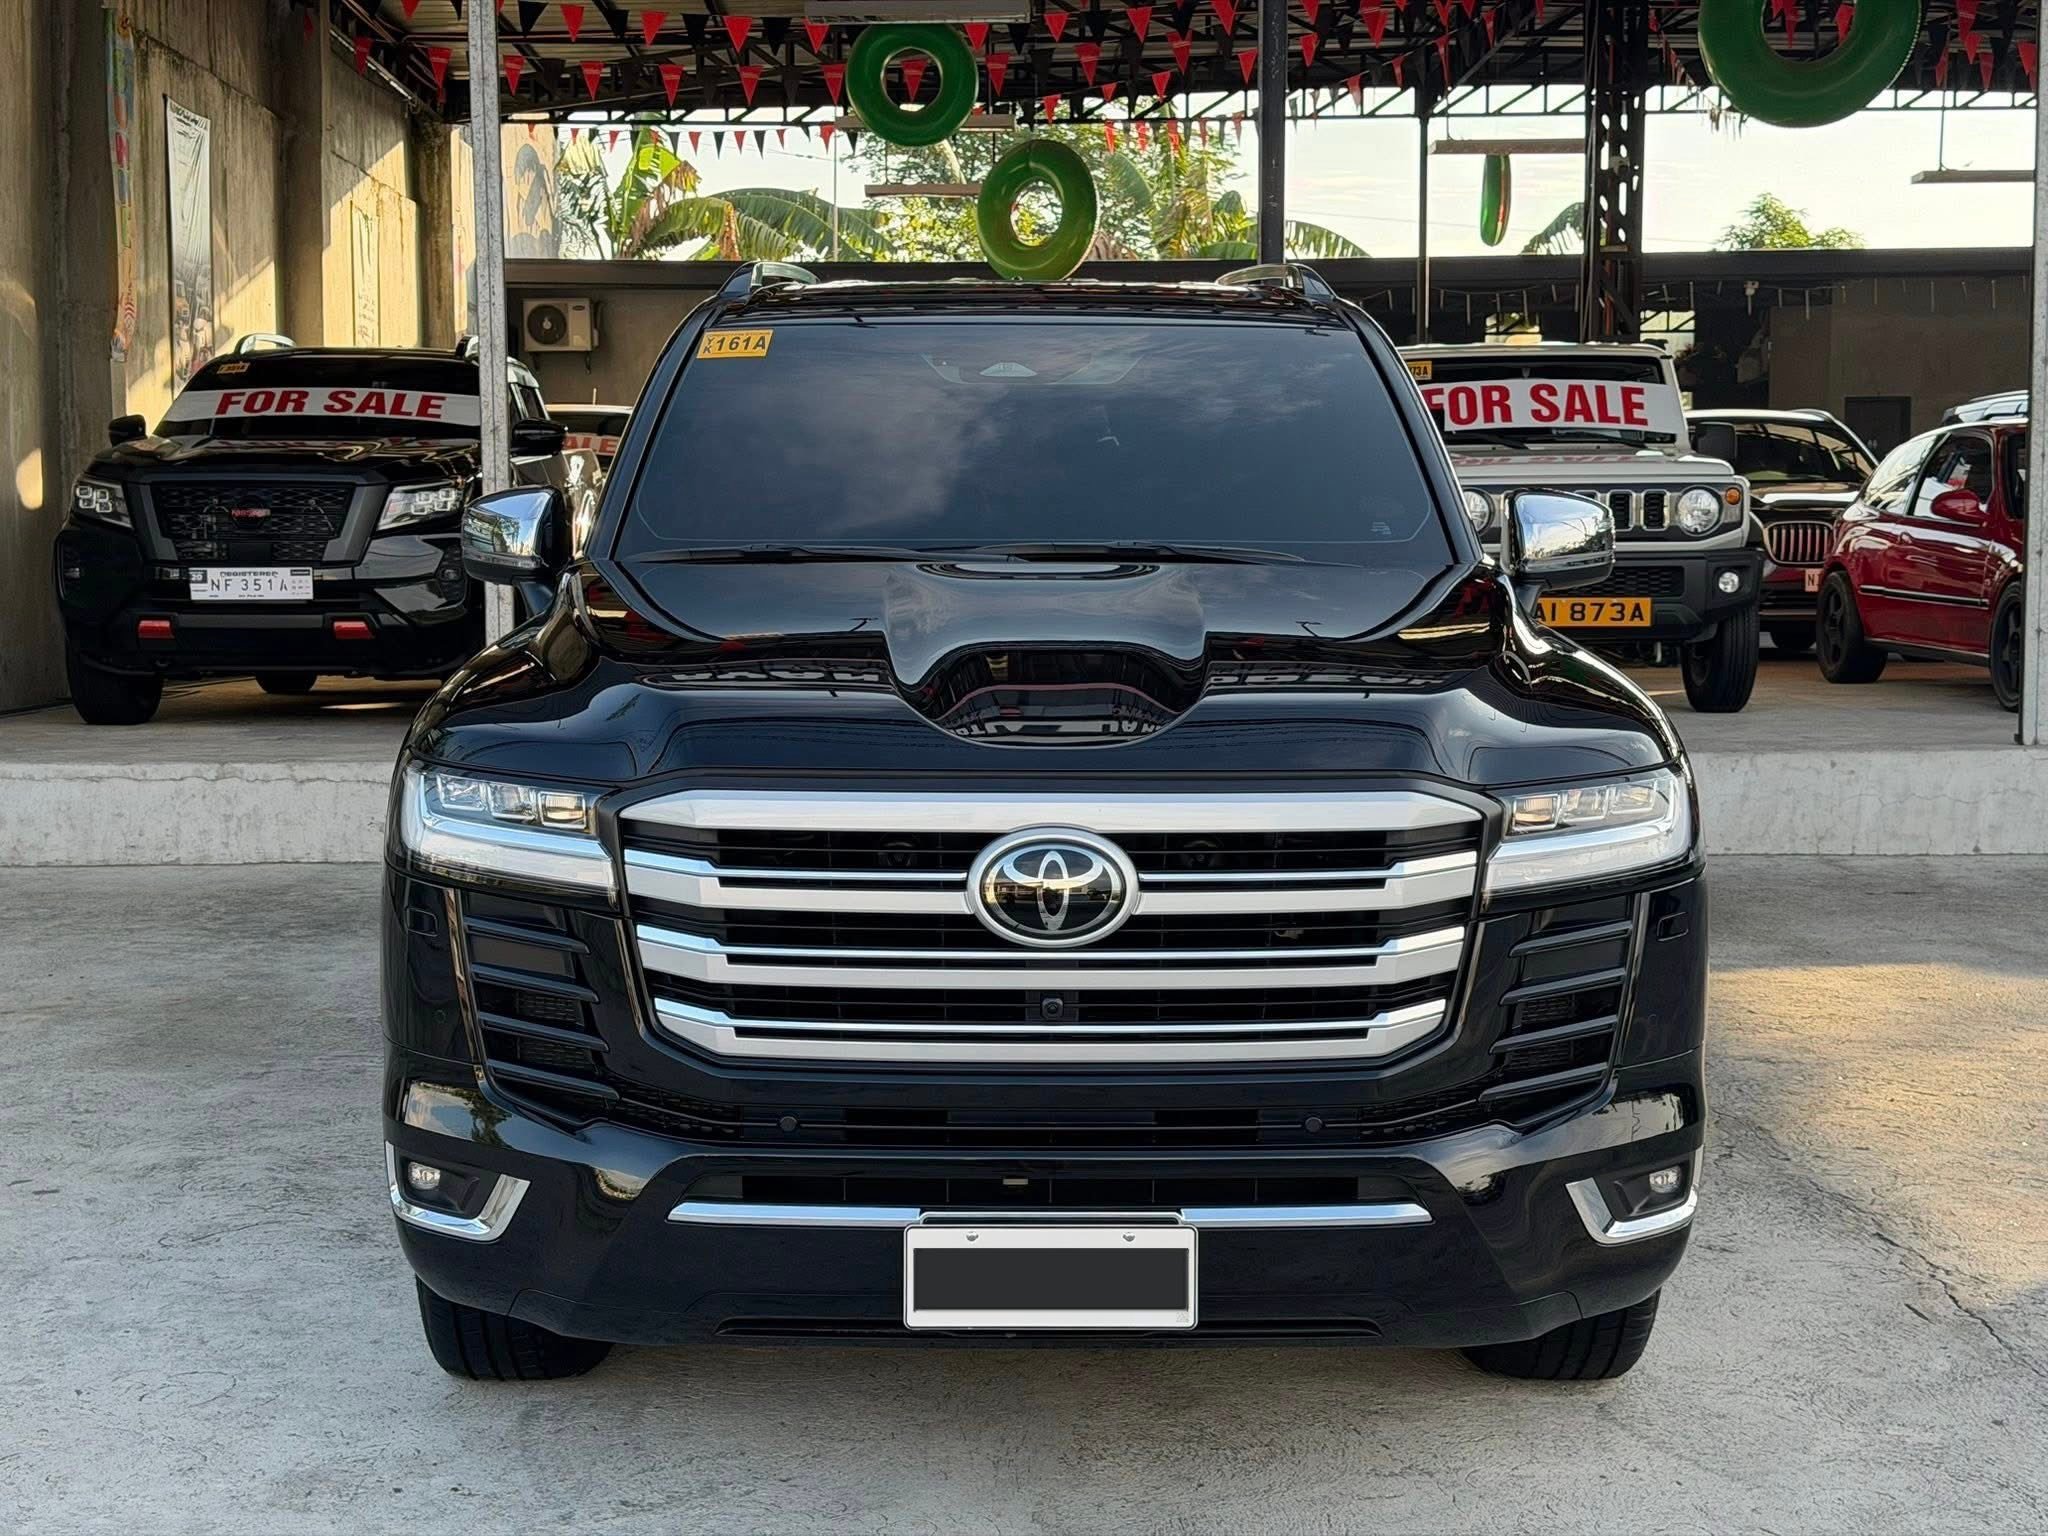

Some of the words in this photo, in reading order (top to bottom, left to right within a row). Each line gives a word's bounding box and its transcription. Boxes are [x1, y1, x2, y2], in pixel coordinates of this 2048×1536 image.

[717, 336, 766, 351] 161A
[216, 391, 309, 415] FOR
[324, 391, 447, 419] SALE
[1423, 385, 1512, 425] FOR
[1530, 384, 1648, 425] SALE
[1570, 602, 1644, 621] 873A
